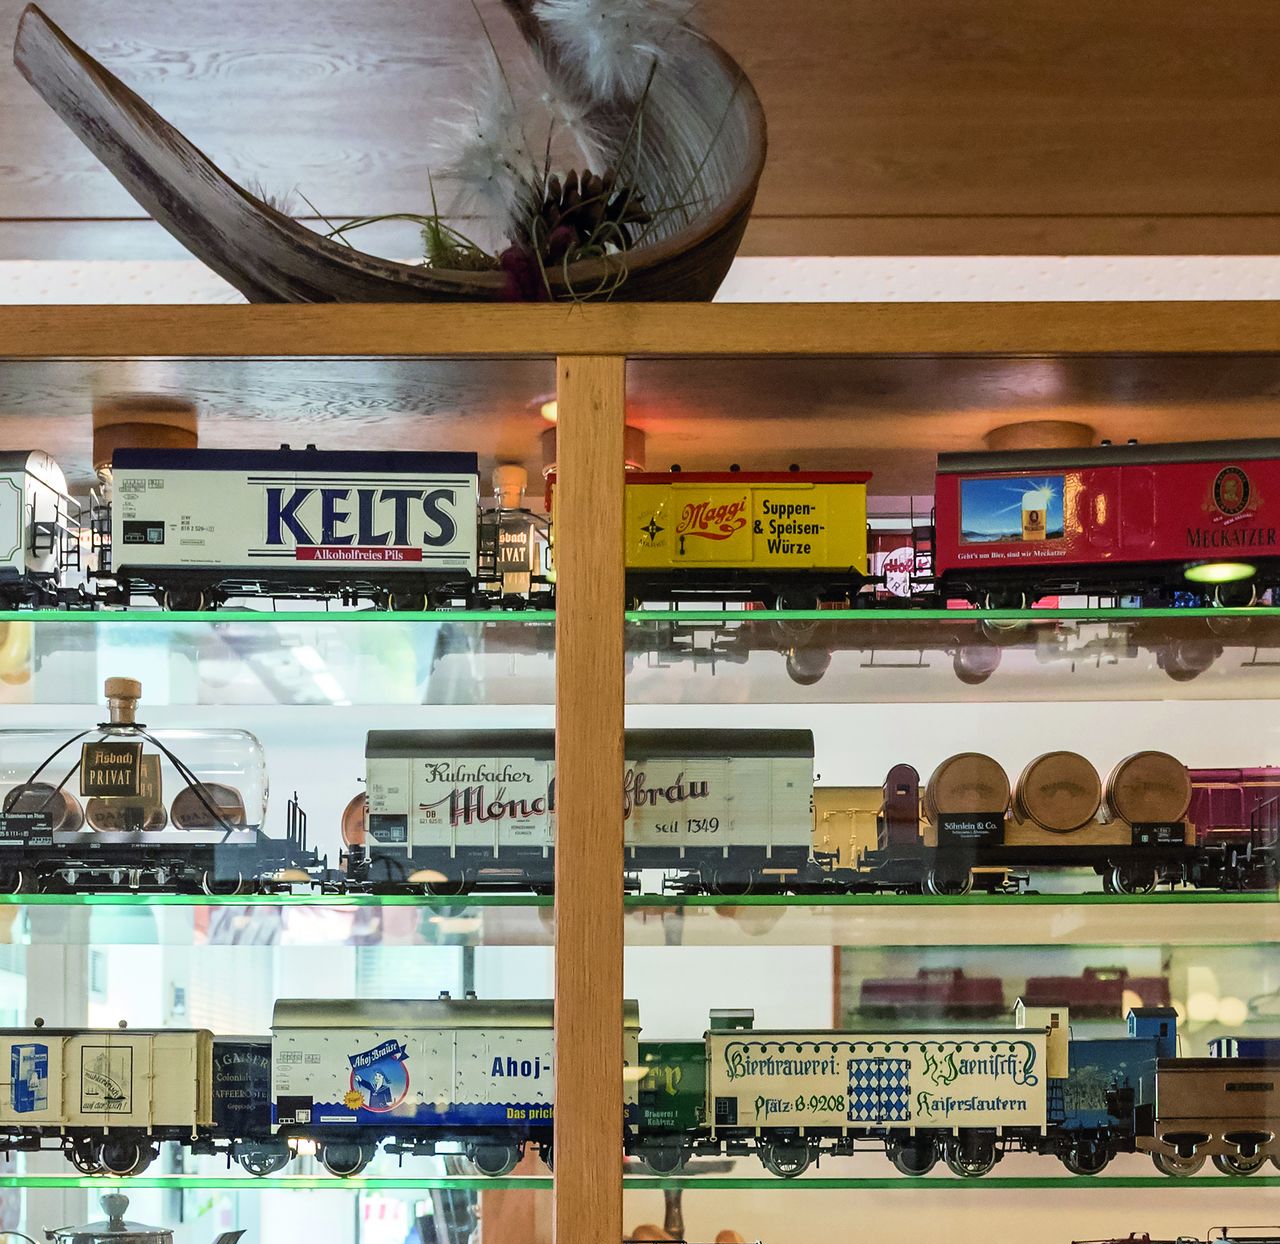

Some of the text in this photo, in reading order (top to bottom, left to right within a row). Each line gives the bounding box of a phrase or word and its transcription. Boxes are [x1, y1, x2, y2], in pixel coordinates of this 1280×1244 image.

[265, 487, 458, 547] KELTS
[762, 500, 816, 519] Suppen-
[676, 496, 747, 540] Maggi
[753, 518, 825, 538] & Speisen-
[499, 531, 527, 545] sbach
[1185, 526, 1277, 549] MECKATZER
[313, 548, 404, 561] Alkoholfreies Pils
[767, 538, 812, 555] Würze
[94, 751, 134, 765] Asbach
[89, 769, 133, 786] PRIVAT
[425, 811, 437, 819] DB
[655, 817, 720, 833] seit 1349
[976, 821, 985, 830] &
[985, 821, 998, 830] Co.
[506, 1107, 526, 1119] Das
